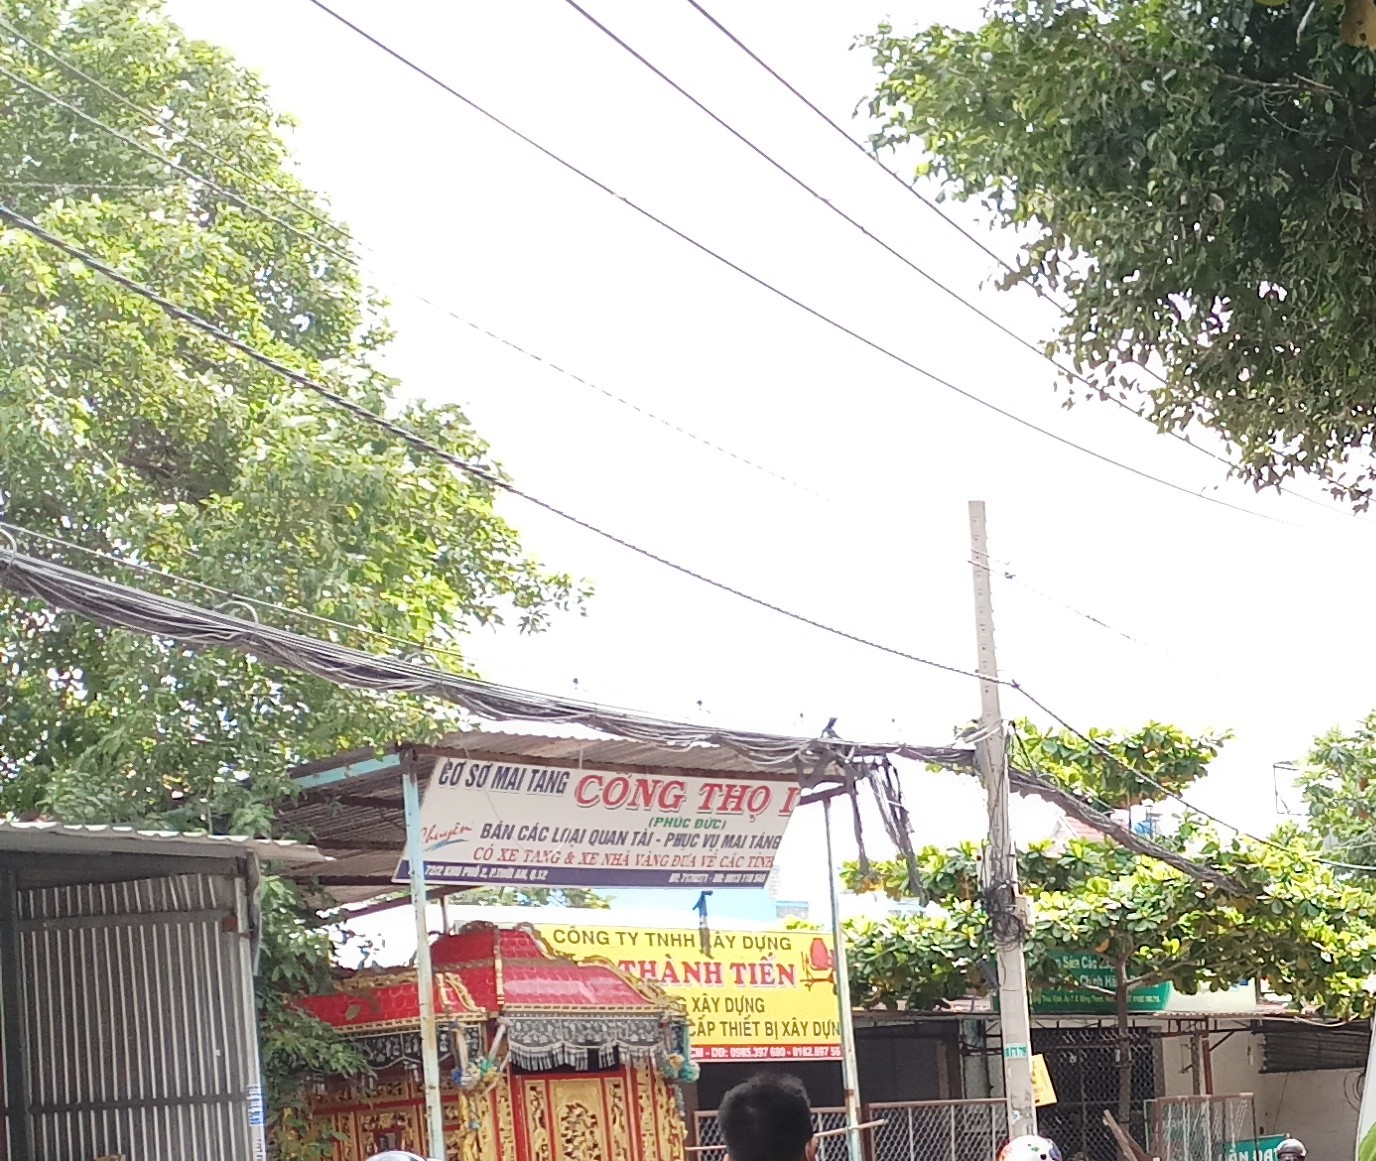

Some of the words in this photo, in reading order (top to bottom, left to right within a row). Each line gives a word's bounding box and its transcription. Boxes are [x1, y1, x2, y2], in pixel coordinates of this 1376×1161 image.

[491, 765, 527, 791] MAI
[697, 782, 772, 822] THỌ
[480, 821, 515, 840] BÁN
[517, 822, 549, 842] CÁC
[588, 830, 629, 847] QUAN
[630, 829, 654, 847] TÀI
[721, 835, 748, 849] MAI
[496, 847, 519, 862] XE
[564, 851, 576, 865] &
[578, 851, 600, 866] XE
[553, 926, 610, 945] CÔNG
[616, 931, 638, 946] TY
[645, 932, 695, 948] TNHH
[743, 935, 792, 952] DỰNG
[618, 953, 723, 986] THÀNH
[730, 952, 796, 985] TIẾN
[692, 993, 719, 1013] XÂY
[725, 995, 765, 1016] DỰNG
[719, 1016, 759, 1037] THIẾT
[765, 1021, 778, 1040] BỊ
[782, 1017, 808, 1037] XÂY
